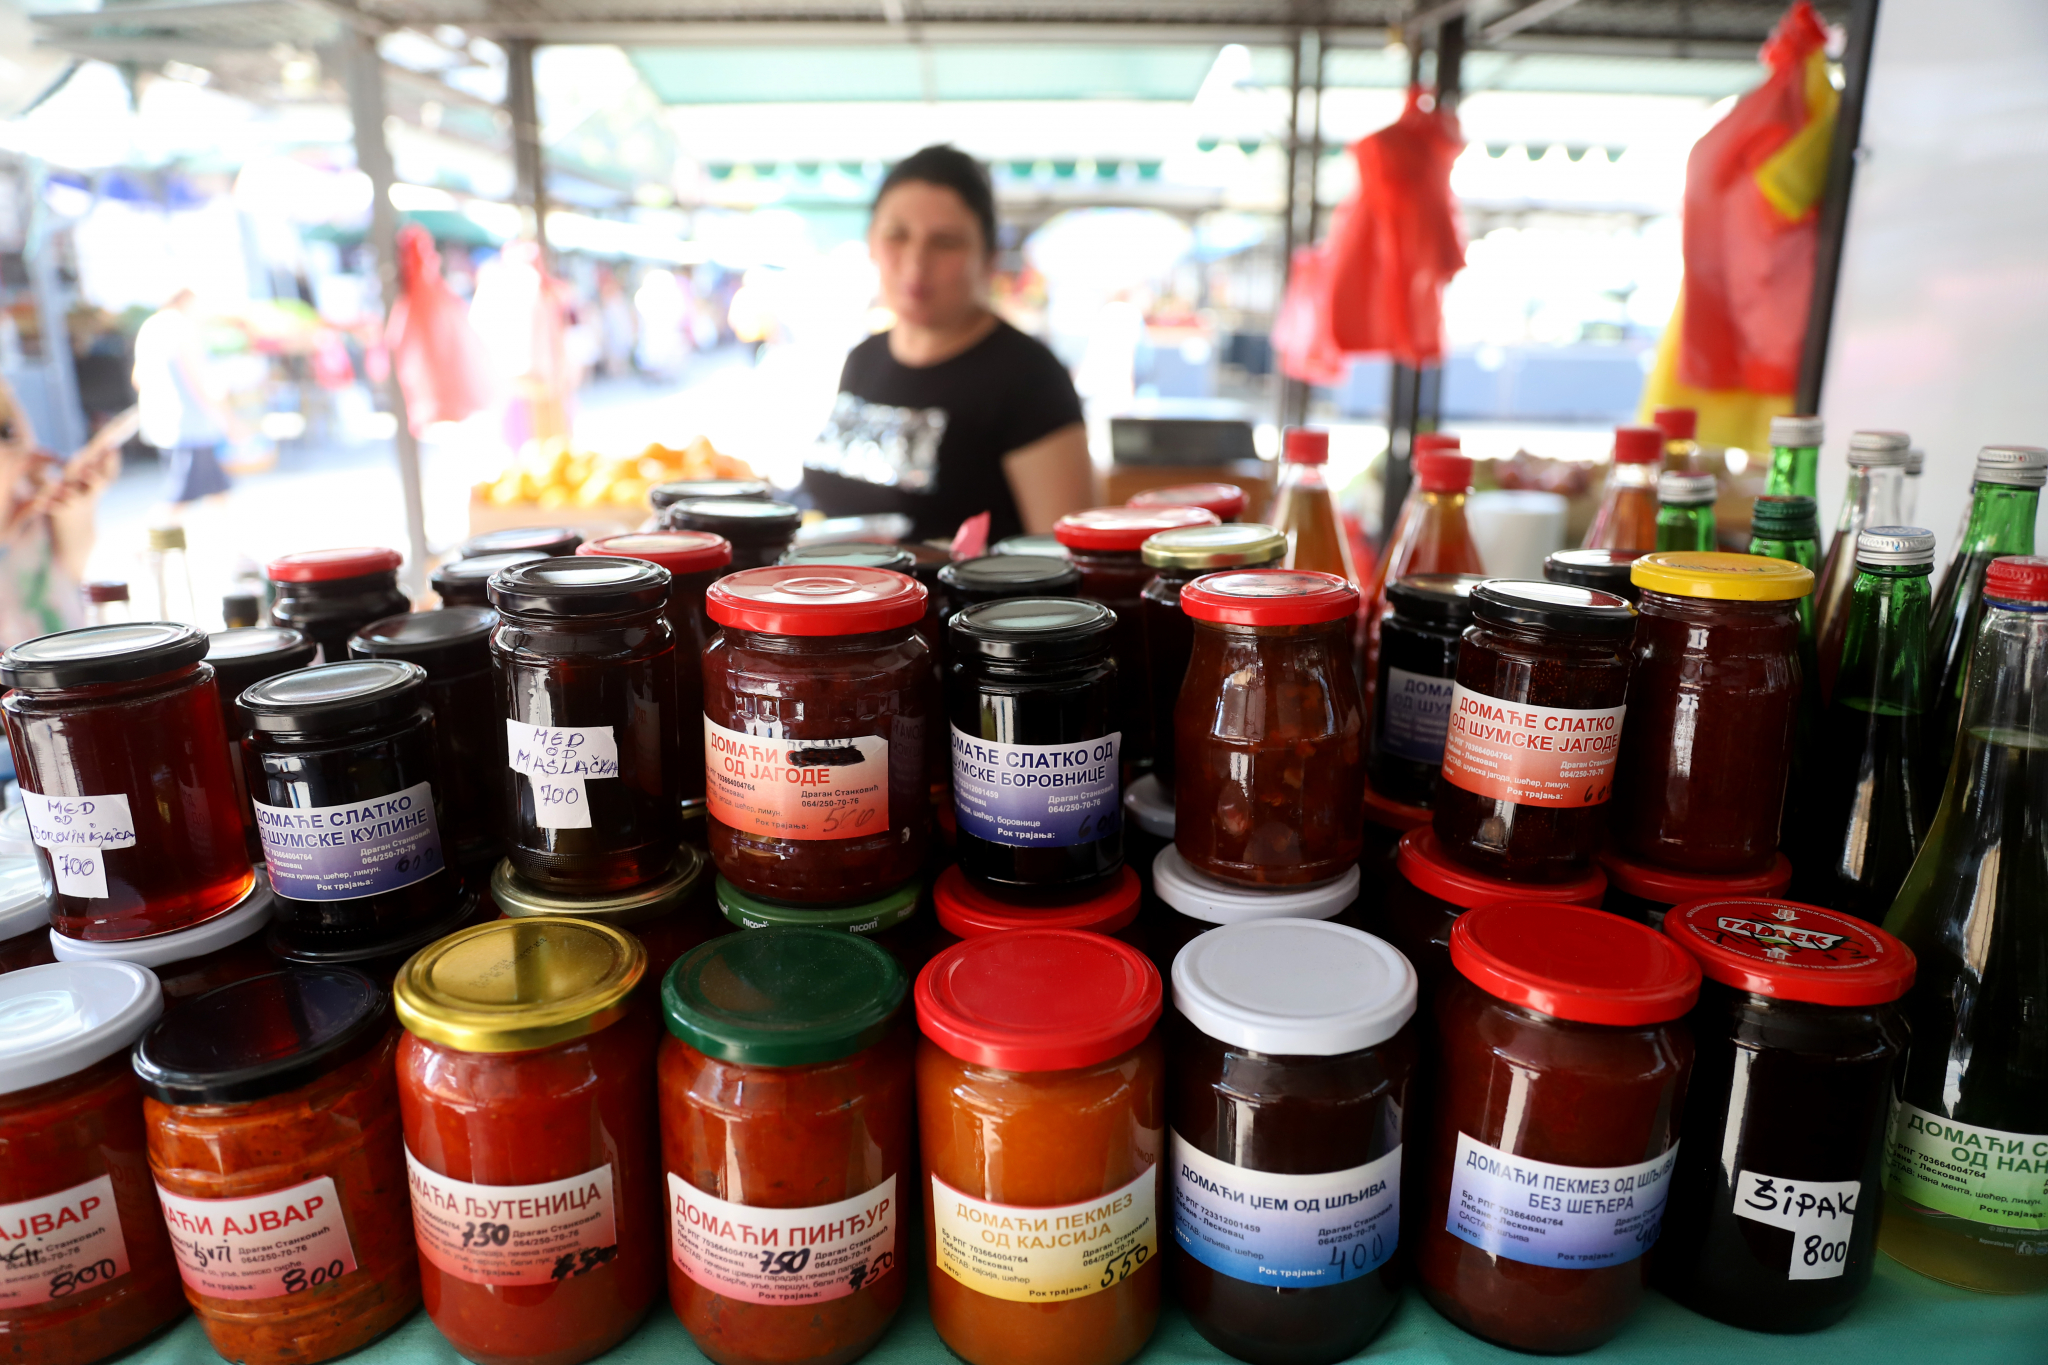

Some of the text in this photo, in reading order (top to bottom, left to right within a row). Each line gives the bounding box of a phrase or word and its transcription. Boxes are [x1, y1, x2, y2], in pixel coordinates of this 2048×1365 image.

[1459, 696, 1538, 729] ДОМАЋЕ
[1544, 716, 1615, 733] СЛАТКО
[533, 728, 585, 748] MED
[1452, 712, 1466, 734] ОД
[1469, 720, 1553, 751] ШУМСКЕ
[1558, 733, 1618, 753] ЈАГОДЕ
[545, 747, 577, 759] OD
[711, 732, 778, 764] ДОМАЋИ
[1006, 749, 1089, 769] СЛАТКО
[1093, 741, 1113, 762] ОД
[1465, 752, 1498, 769] Лесковац
[724, 756, 745, 779] ОД
[750, 767, 830, 787] ЈАГОДЕ
[1001, 765, 1106, 788] БОРОВНИЦЕ
[1560, 760, 1587, 769] Драган
[540, 784, 579, 807] 700
[801, 784, 879, 799] Драган Станковић
[801, 797, 859, 808] 064/250-70-76
[1048, 794, 1079, 805] Драган
[1048, 798, 1101, 813] 064/250-70-76
[1506, 786, 1563, 801] Рок трајања:
[47, 800, 96, 815] MED
[256, 796, 412, 829] ДОМАЋЕ СЛАТКО
[997, 814, 1041, 828] боровнице
[267, 831, 345, 848] ШУМСКЕ
[351, 808, 428, 844] КУПИНЕ
[755, 818, 809, 830] Рок трајања:
[997, 828, 1056, 840] Рок трајања:
[360, 828, 431, 857] Драган Станковић
[361, 844, 417, 865] 064/250-70-76
[58, 853, 96, 879] 700
[323, 867, 382, 881] шећер, лимун.
[316, 879, 374, 892] Рок трајања:
[849, 919, 878, 933] nicom
[1721, 918, 1830, 949] TAMEK
[1907, 1114, 2024, 1156] ДОМАЋИ
[1466, 1150, 1538, 1188] ДОМАЋИ
[1543, 1175, 1610, 1194] ПЕКМЕЗ
[1614, 1176, 1634, 1193] ОД
[1897, 1142, 1986, 1179] РПГ 703664004764
[1951, 1147, 1988, 1171] ОД
[1919, 1162, 1968, 1185] Лесковац
[465, 1182, 602, 1220] ЉУТЕНИЦА
[1181, 1164, 1387, 1213] ДОМАЋИ ЏЕМ ОД ШЉИВА
[1744, 1178, 1856, 1220] ŠIPAK
[1917, 1172, 2009, 1204] нана мента, шећер,
[223, 1196, 325, 1237] АЈВАР
[956, 1193, 1133, 1232] ДОМАЋИ ПЕКМЕЗ
[1185, 1195, 1261, 1234] РПГ 723312001459
[1460, 1199, 1546, 1235] Лебане Лесковац
[1461, 1189, 1564, 1227] Бр. РПГ 703664004764
[1528, 1193, 1561, 1211] БЕЗ
[1567, 1195, 1634, 1214] ШЕЋЕРА
[1979, 1204, 2047, 1219] Рок трајања:
[513, 1211, 602, 1239] Драган Станковић
[676, 1195, 890, 1248] ДОМАЋИ ПИНЂУР
[1202, 1217, 1245, 1240] Лесковац
[1317, 1204, 1393, 1238] Драган Станковић
[1317, 1223, 1377, 1246] 064/250-70-76
[1457, 1222, 1481, 1240] Нето:
[1458, 1211, 1530, 1243] САСТАВ: шљива
[45, 1226, 107, 1253] Станковић
[238, 1226, 331, 1256] Драган Станковић
[677, 1228, 745, 1268] Лебане Лесковац
[687, 1228, 759, 1260] РПГ 703664004764
[814, 1225, 888, 1260] Драган Станковић
[941, 1227, 1029, 1264] Бр. РПГ 703664004764
[981, 1222, 1111, 1250] ОД КАЈСИЈА
[1082, 1216, 1150, 1259] Драган Станковић
[1175, 1211, 1265, 1261] САСТАВ: шљива, шећер
[241, 1244, 308, 1264] 064/250-70-76
[677, 1239, 703, 1263] САСТАВ:
[759, 1248, 810, 1274] 750
[814, 1245, 872, 1269] 064/250-70-76
[942, 1237, 1014, 1272] Лебане Лесковац
[1082, 1238, 1135, 1267] 064/250-70-76
[1557, 1252, 1575, 1261] Рок
[1803, 1235, 1847, 1266] 800
[49, 1258, 117, 1299] 800
[282, 1259, 345, 1295] 800
[943, 1247, 1031, 1285] САСТАВ: кајсија, шећер
[943, 1260, 962, 1279] Нето:
[1100, 1243, 1149, 1288] 550
[1258, 1266, 1326, 1279] Рок трајања:
[758, 1290, 822, 1300] Рок трајања:
[1028, 1283, 1092, 1297] Рок трајања:
